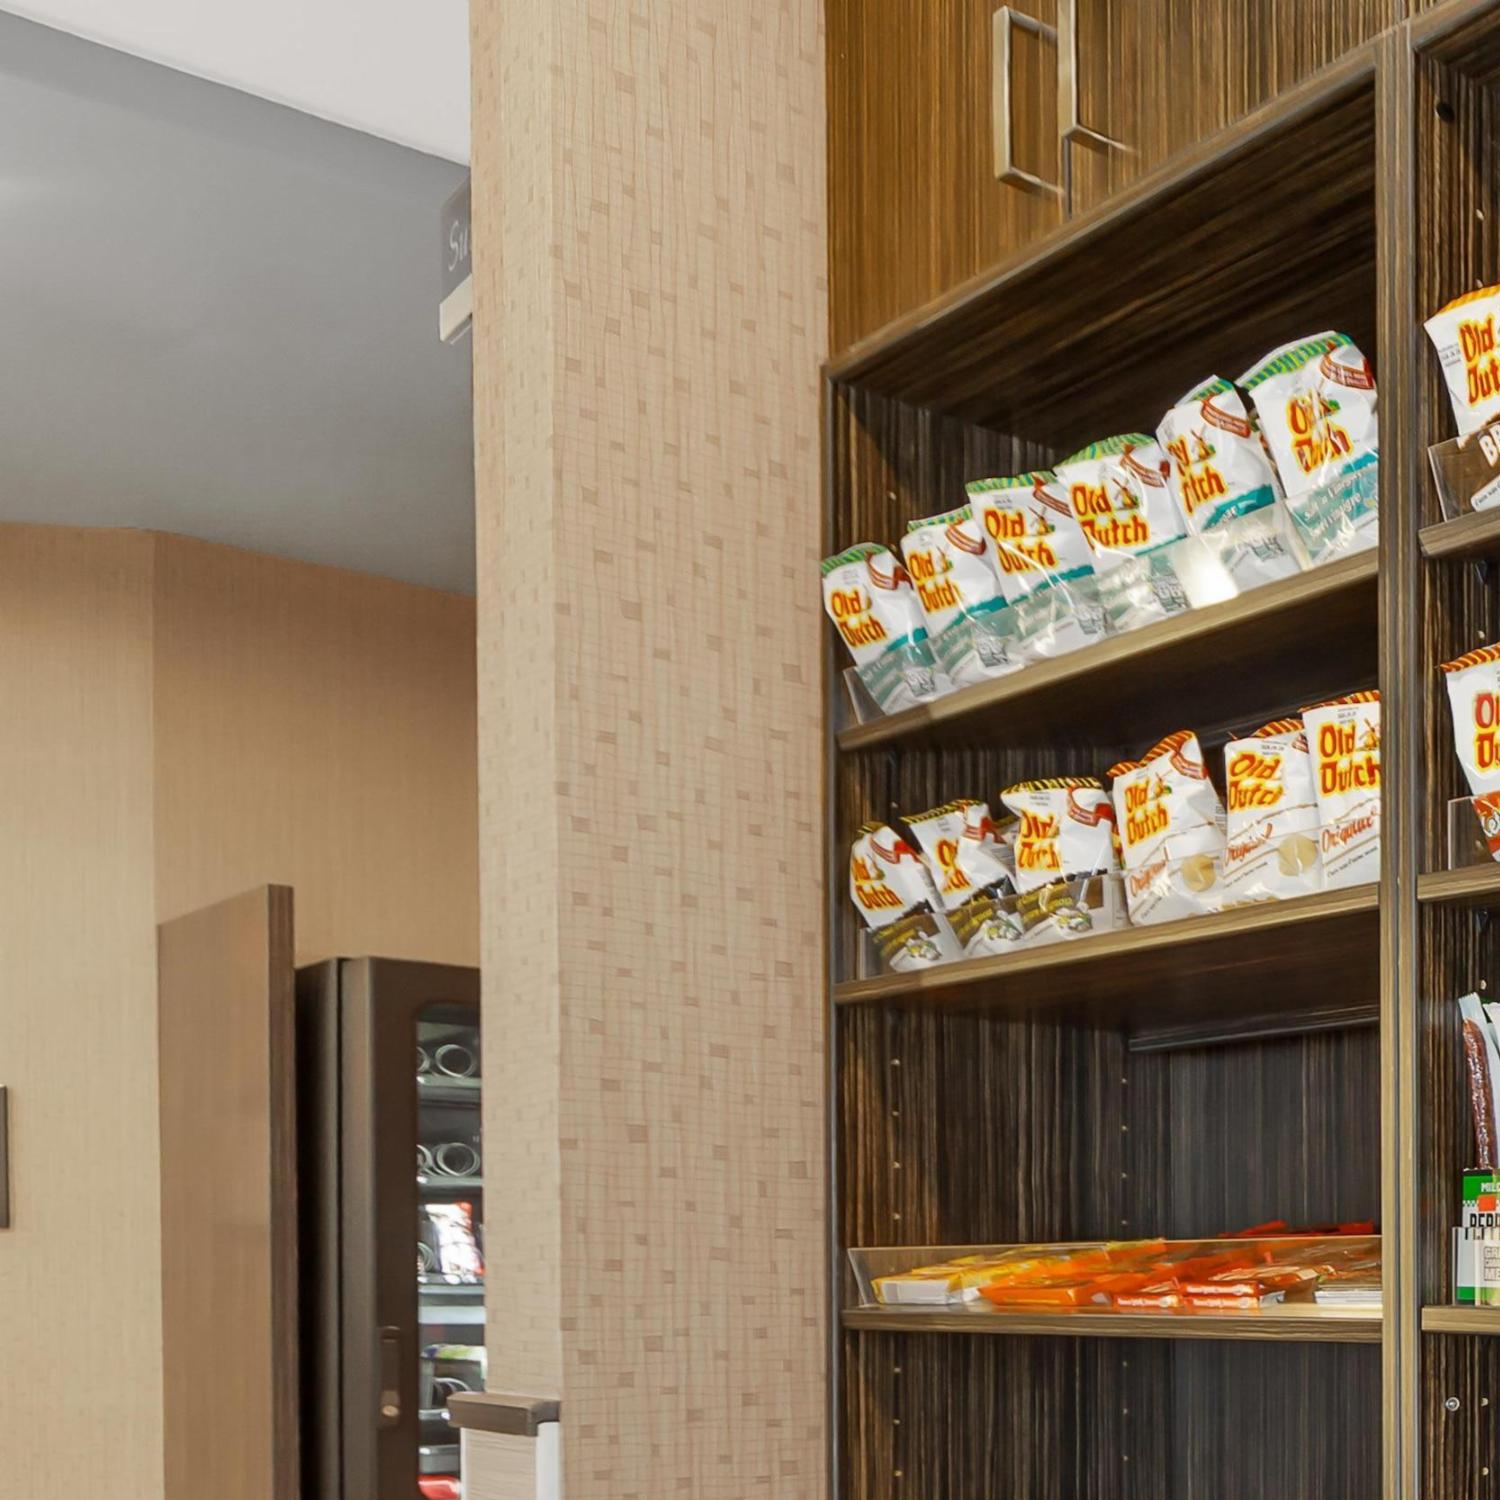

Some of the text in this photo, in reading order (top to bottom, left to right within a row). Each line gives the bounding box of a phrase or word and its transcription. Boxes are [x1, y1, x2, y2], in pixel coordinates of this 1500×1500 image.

[1460, 317, 1495, 363] Old
[1071, 484, 1112, 516] Old
[984, 509, 1025, 539] Old
[1080, 515, 1149, 549] Dutch
[908, 552, 935, 581] Old
[831, 589, 861, 617] Old
[1320, 724, 1356, 758] Old
